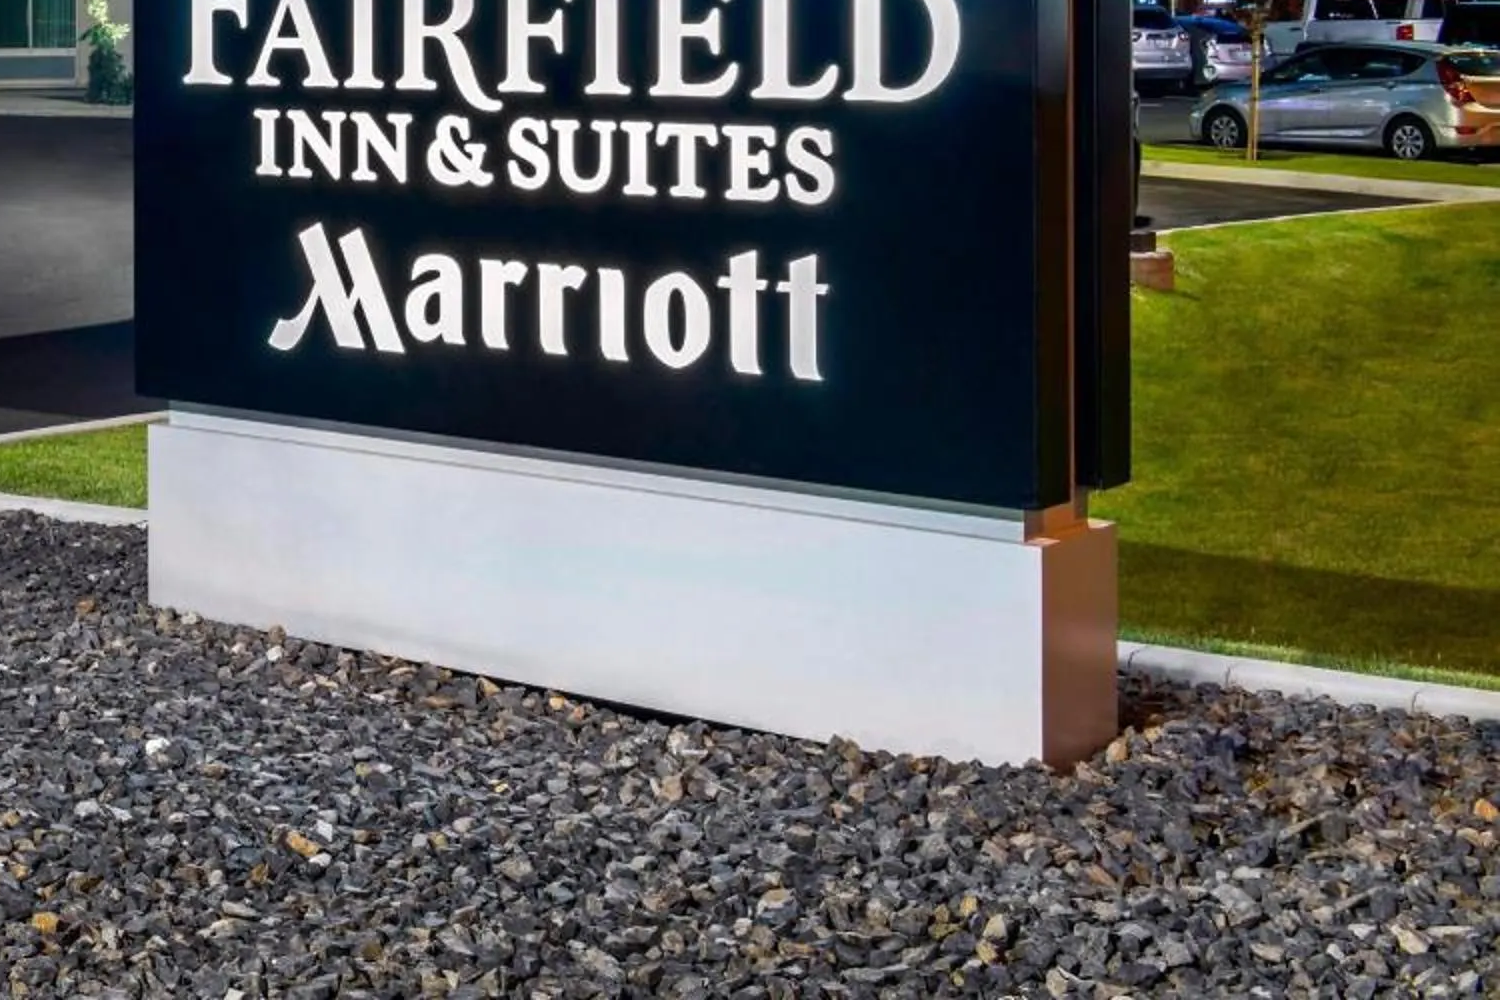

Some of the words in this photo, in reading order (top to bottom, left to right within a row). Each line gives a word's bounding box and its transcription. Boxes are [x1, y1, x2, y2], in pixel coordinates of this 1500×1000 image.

[252, 108, 414, 184] INN
[426, 114, 494, 188] &
[507, 116, 836, 206] SUITES
[268, 222, 829, 382] Marriott
